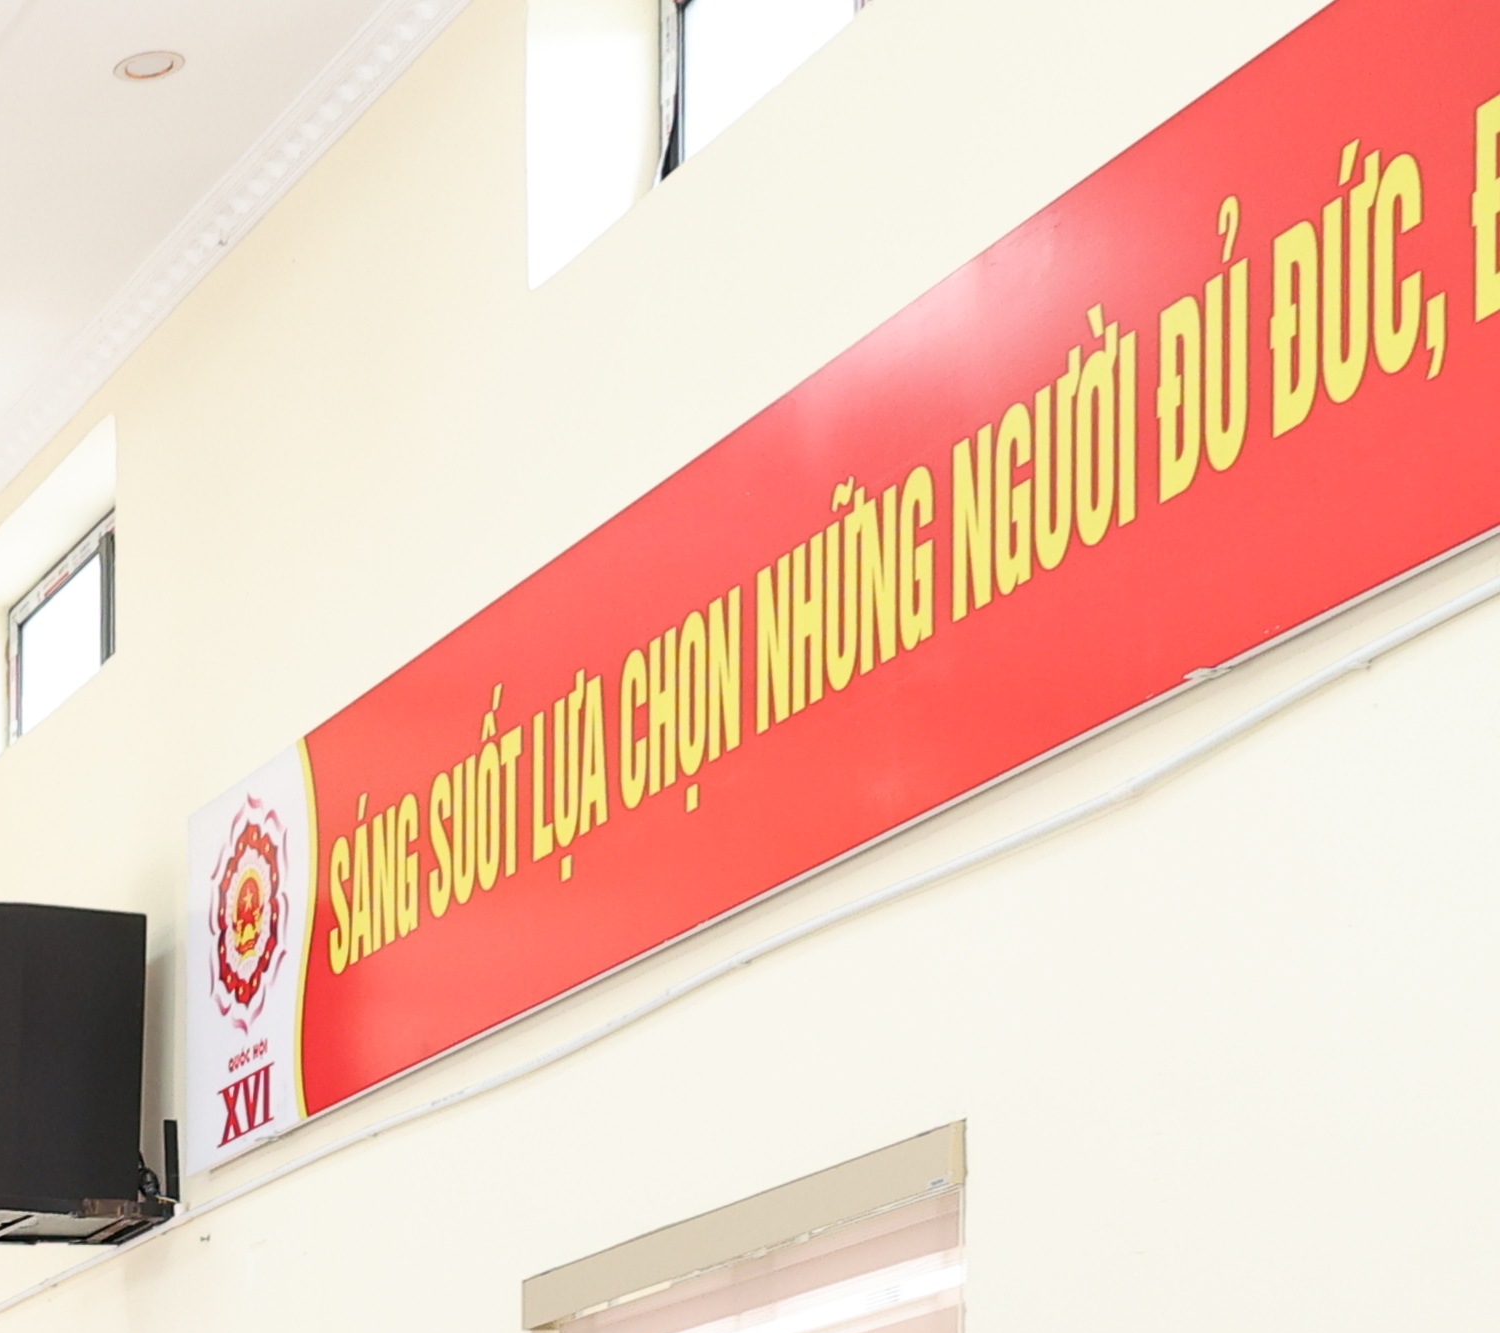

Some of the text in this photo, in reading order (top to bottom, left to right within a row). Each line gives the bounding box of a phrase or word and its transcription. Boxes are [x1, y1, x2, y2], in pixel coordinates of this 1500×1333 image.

[329, 793, 419, 975] SÁNG
[428, 684, 523, 918] SUỐT
[532, 670, 608, 881] LỰA
[620, 586, 741, 812] CHỌN
[756, 465, 934, 734] NHỮNG
[952, 305, 1137, 622] NGƯỜI
[1156, 196, 1248, 502] ĐỦ
[1269, 140, 1446, 437] ĐỨC,
[217, 1062, 275, 1148] XVI
